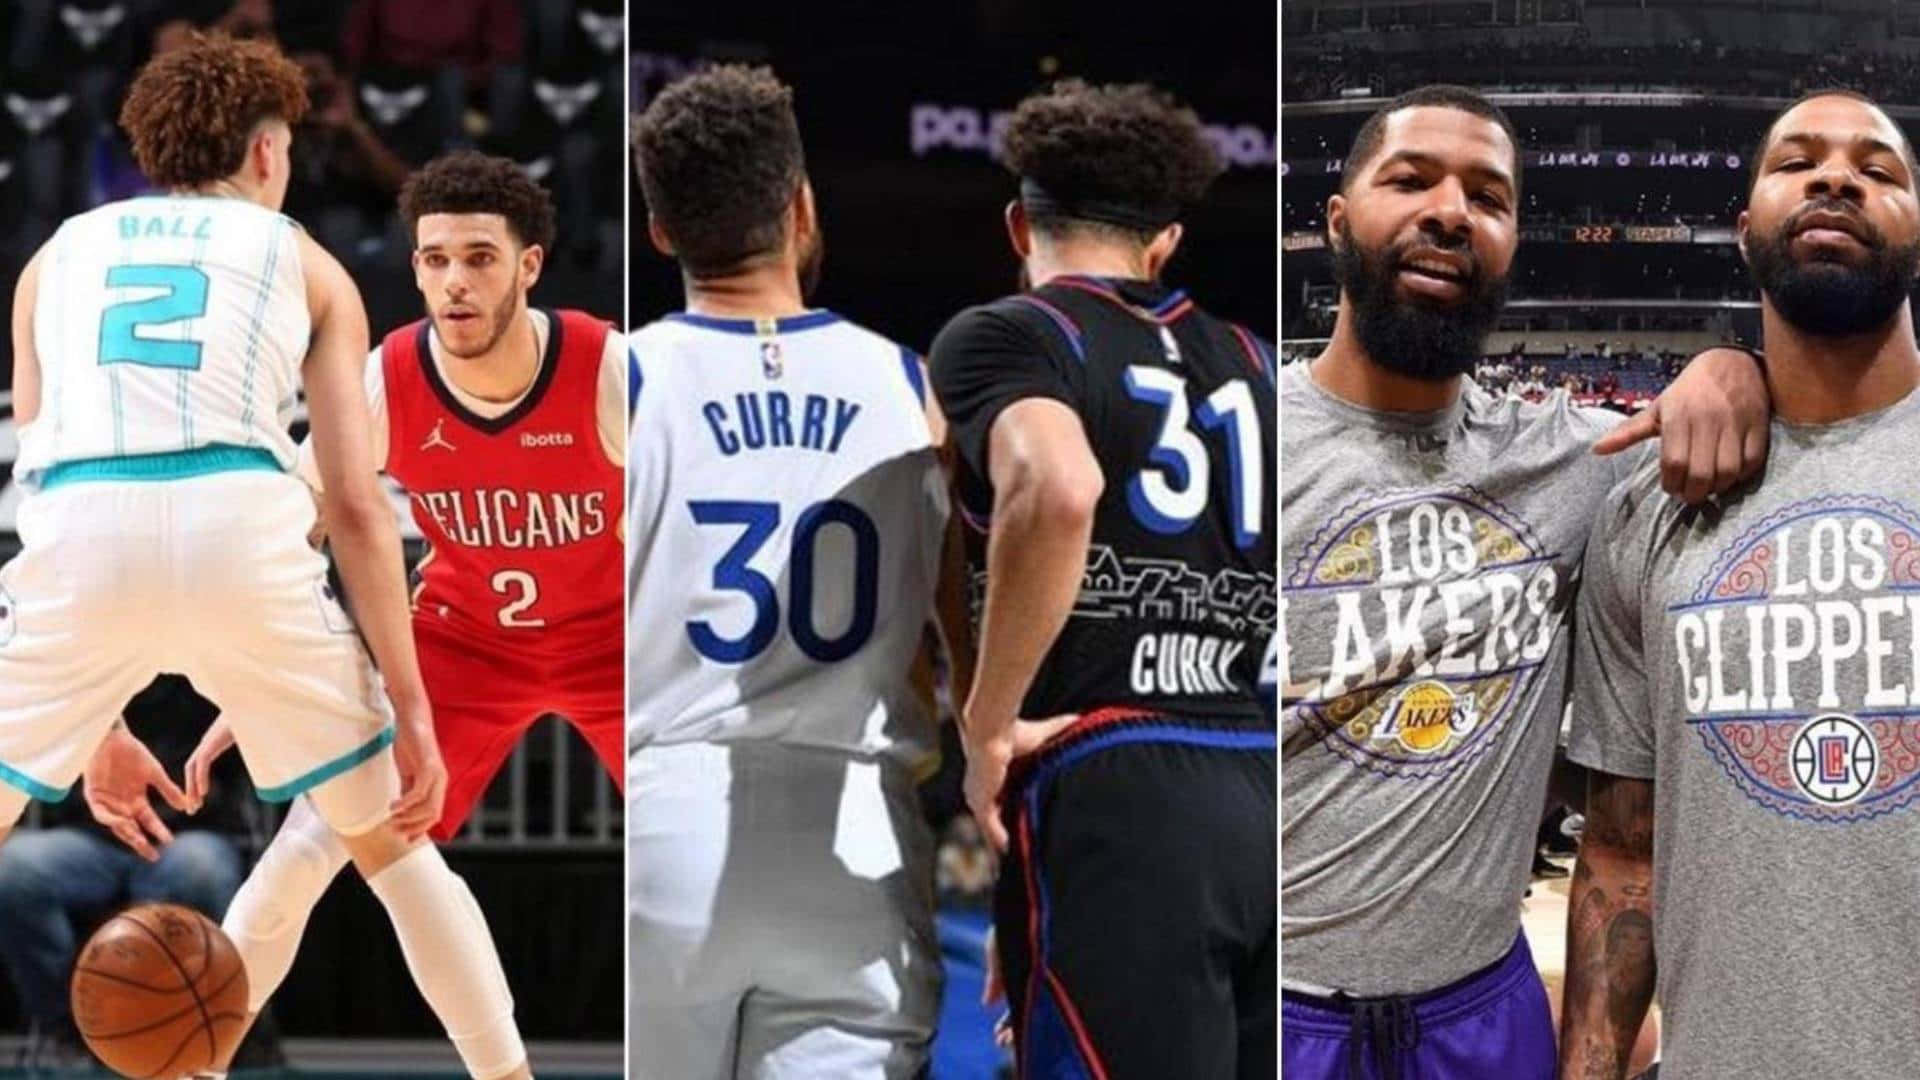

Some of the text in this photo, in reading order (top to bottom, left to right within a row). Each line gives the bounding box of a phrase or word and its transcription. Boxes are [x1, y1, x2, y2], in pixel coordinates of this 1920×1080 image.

[118, 216, 212, 240] BALL
[98, 263, 211, 371] 2
[520, 432, 574, 448] ibotta
[702, 391, 861, 457] CURRY
[1123, 363, 1263, 550] 31
[685, 500, 881, 664] 30
[1375, 503, 1478, 583] LOS
[1773, 516, 1889, 596] LOS
[491, 569, 546, 628] 2
[1130, 632, 1246, 695] CURRY
[1675, 595, 1920, 714] CLIPPE
